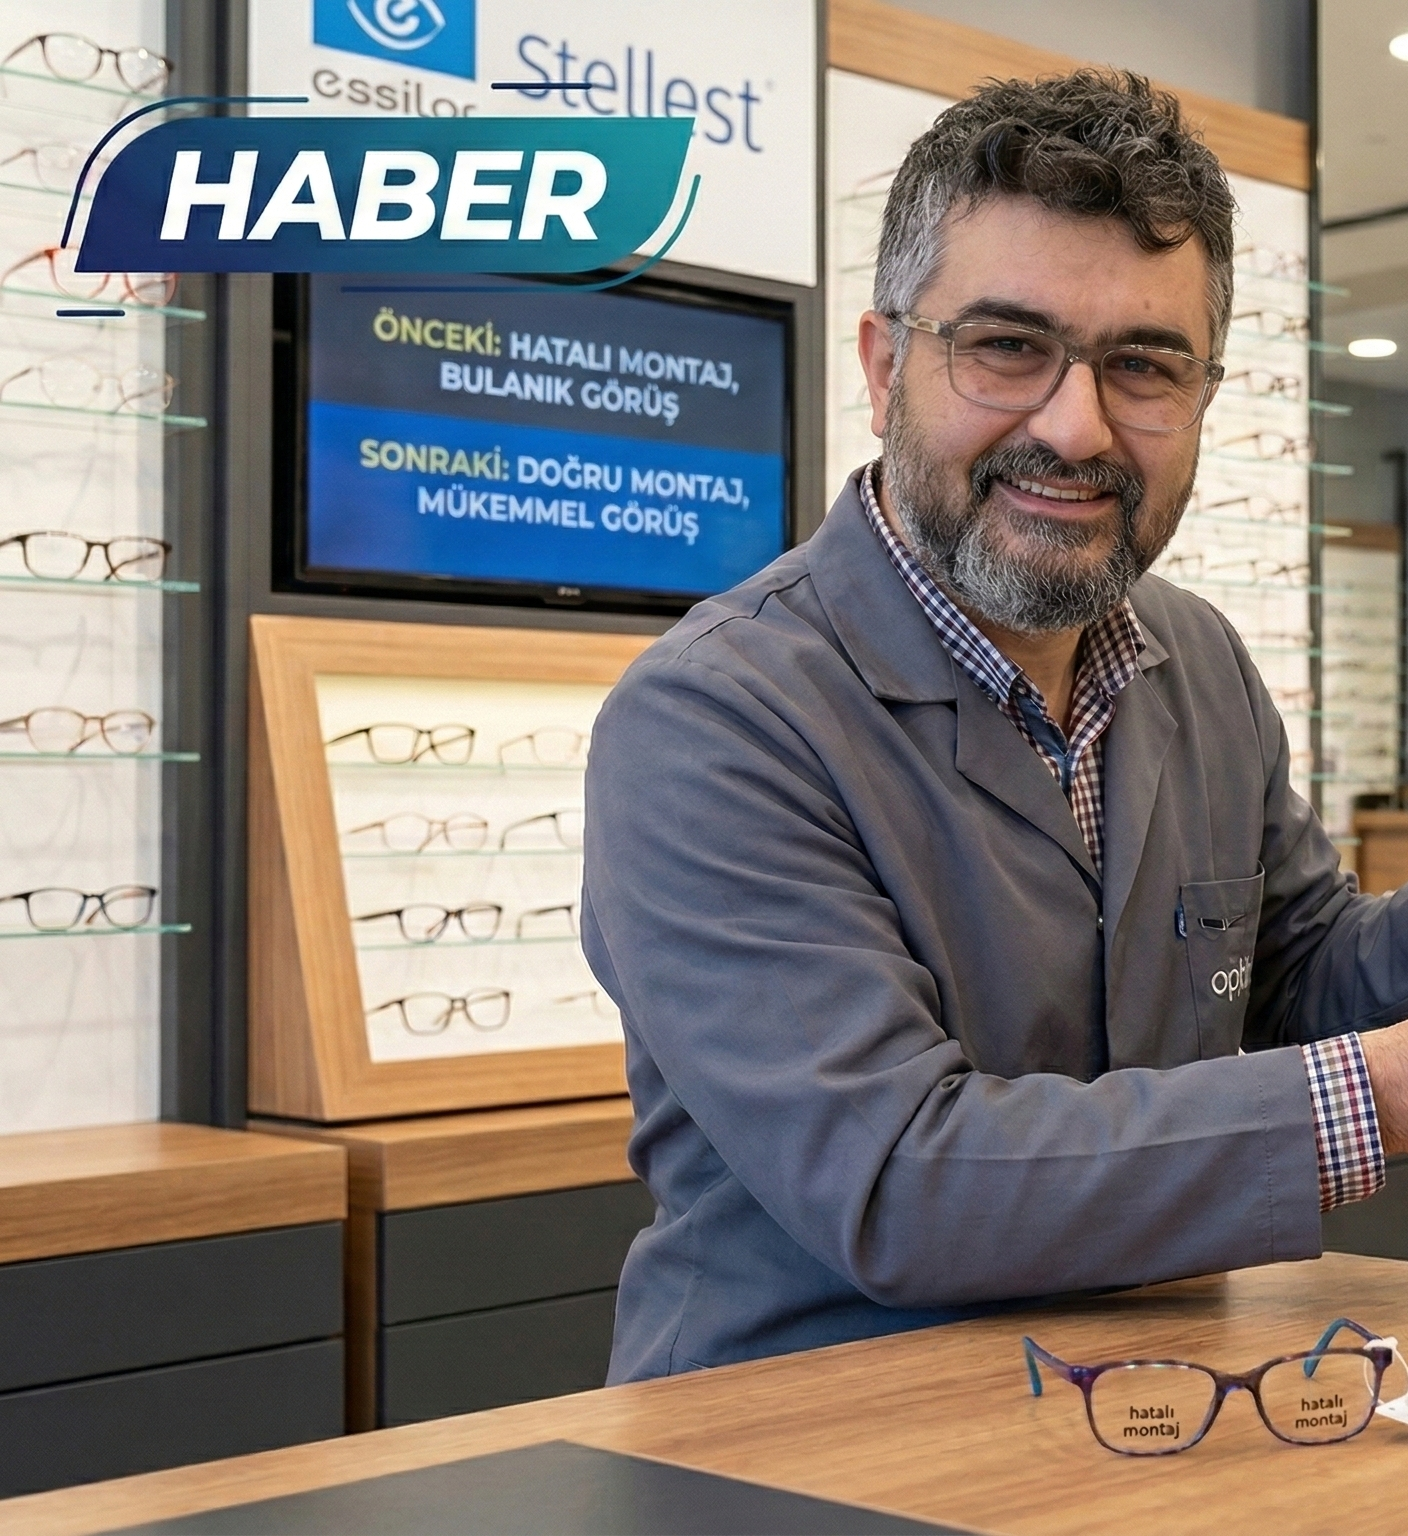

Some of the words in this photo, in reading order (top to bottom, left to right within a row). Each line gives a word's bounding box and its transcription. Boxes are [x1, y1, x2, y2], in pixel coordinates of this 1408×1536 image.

[517, 34, 764, 154] Stellest
[373, 306, 502, 357] ÖNCEKİ:
[509, 330, 612, 372] HATALI
[618, 347, 741, 396] MONTAJ,
[440, 361, 575, 407] BULANIK
[580, 377, 681, 427] GÖRÜŞ
[360, 437, 510, 482] SONRAKİ:
[517, 453, 623, 493] DOĞRU
[630, 467, 751, 511] MONTAJ,
[417, 482, 595, 530] MÜKEMMEL
[600, 499, 700, 546] GÖRÜŞ
[1123, 1421, 1180, 1440] montaj
[1129, 1404, 1175, 1420] hatalı
[1295, 1410, 1348, 1429] montaj
[1301, 1394, 1344, 1412] hatalı
